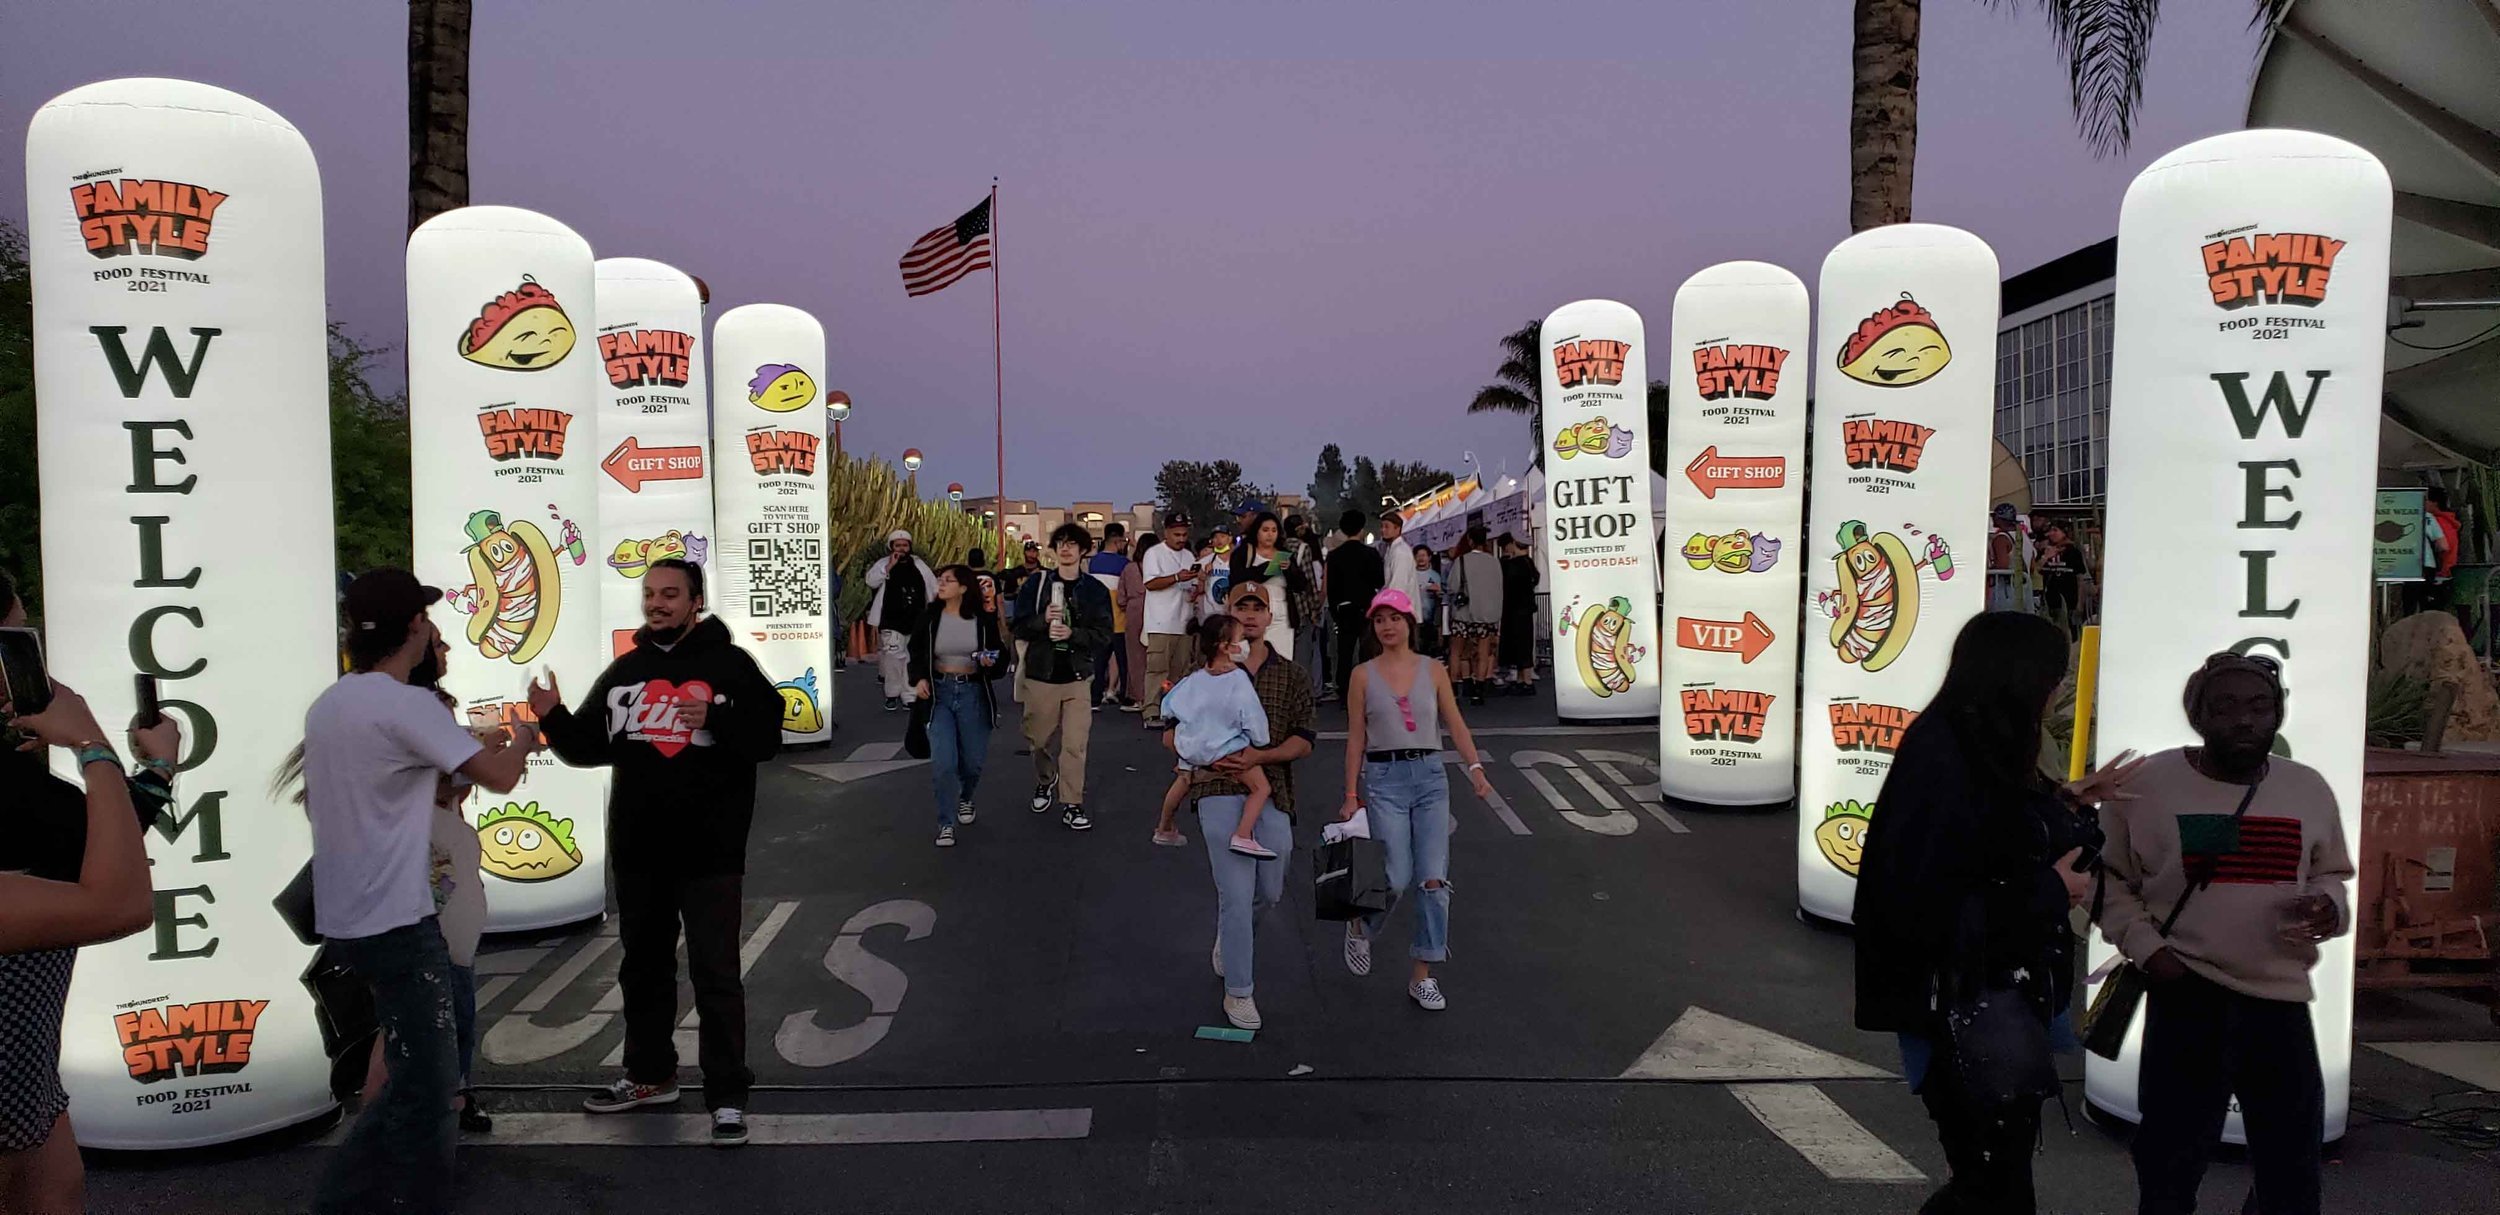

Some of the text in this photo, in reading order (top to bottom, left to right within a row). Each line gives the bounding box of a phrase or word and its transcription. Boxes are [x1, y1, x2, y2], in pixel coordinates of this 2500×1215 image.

[70, 179, 229, 221] FAMILY
[80, 214, 211, 257] STYLE
[2201, 233, 2347, 276] FAMILY
[93, 268, 210, 284] FOOD FESTIVAL
[127, 281, 167, 292] 2021
[2208, 267, 2330, 306] STYLE
[2219, 317, 2326, 331] FOOD FESTIVAL
[2252, 329, 2288, 340] 2021
[597, 330, 695, 361] FAMILY
[1553, 339, 1632, 367] FAMILY
[1693, 344, 1790, 374] FAMILY
[606, 355, 689, 387] STYLE
[1558, 361, 1623, 386] STYLE
[1697, 369, 1779, 398] STYLE
[616, 395, 690, 406] FOOD FESTIVAL
[1563, 393, 1584, 403] FOOD
[641, 405, 668, 413] 2021
[1702, 407, 1776, 417] FOOD FESTIVAL
[477, 408, 573, 437] FAMILY
[1724, 416, 1750, 424] 2021
[745, 430, 821, 455] FAMILY
[1843, 419, 1936, 448] FAMILY
[484, 431, 564, 459] STYLE
[627, 456, 701, 471] GIFT SHOP
[751, 451, 815, 474] STYLE
[1845, 442, 1922, 471] STYLE
[494, 467, 565, 477] FOOD FESTIVAL
[518, 475, 542, 483] 2021
[1706, 466, 1783, 479] GIFT SHOP
[758, 481, 815, 490] FOOD FESTIVAL
[1553, 475, 1634, 508] GIFT
[1848, 476, 1916, 490] FOOD FESTIVAL
[1866, 485, 1889, 494] 2021
[763, 505, 786, 513] SCAN
[748, 522, 820, 534] GIFT SHOP
[1555, 513, 1636, 541] SHOP
[1564, 546, 1612, 555] PRESENTED
[1574, 557, 1638, 568] DOORDASH
[772, 632, 823, 640] DOORDASH
[1691, 624, 1743, 648] VIP
[1680, 688, 1776, 716] FAMILY
[1685, 712, 1765, 740] STYLE
[1828, 703, 1921, 730] FAMILY
[1690, 748, 1762, 760] FOOD FESTIVAL
[1711, 757, 1737, 766] 2021
[1856, 767, 1879, 776] 2021
[1864, 759, 1891, 769] FESTI
[1441, 749, 1692, 835] TOP
[113, 999, 270, 1045] FAMILY
[123, 1033, 254, 1081] STYLE
[136, 1083, 252, 1107] FOOD FESTIVAL
[172, 1100, 211, 1114] 2021
